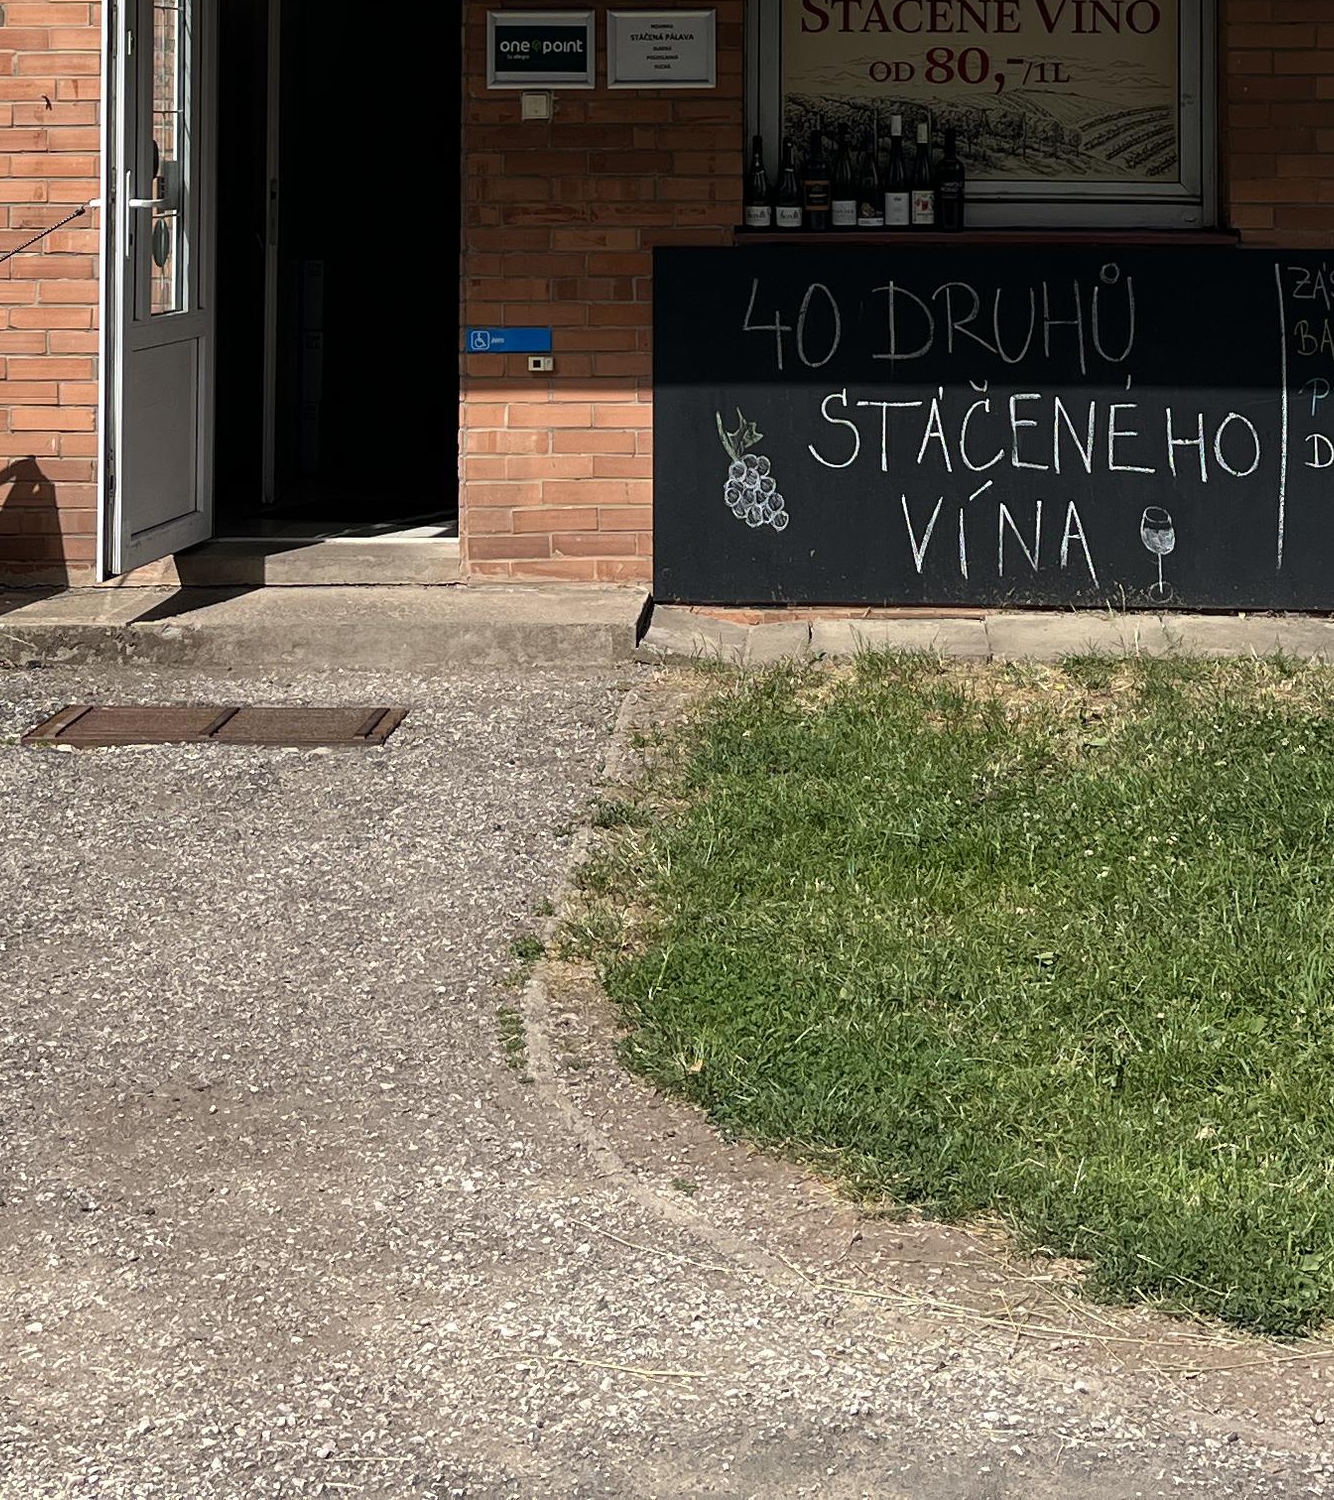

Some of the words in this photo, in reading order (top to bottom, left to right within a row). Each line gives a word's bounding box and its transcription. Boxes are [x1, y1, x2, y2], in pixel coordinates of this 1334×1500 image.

[499, 41, 530, 53] one
[542, 39, 584, 54] point
[868, 60, 915, 83] OD
[742, 278, 842, 371] 40
[871, 263, 1136, 375] DRUHŮ
[900, 480, 1101, 590] VÍNA
